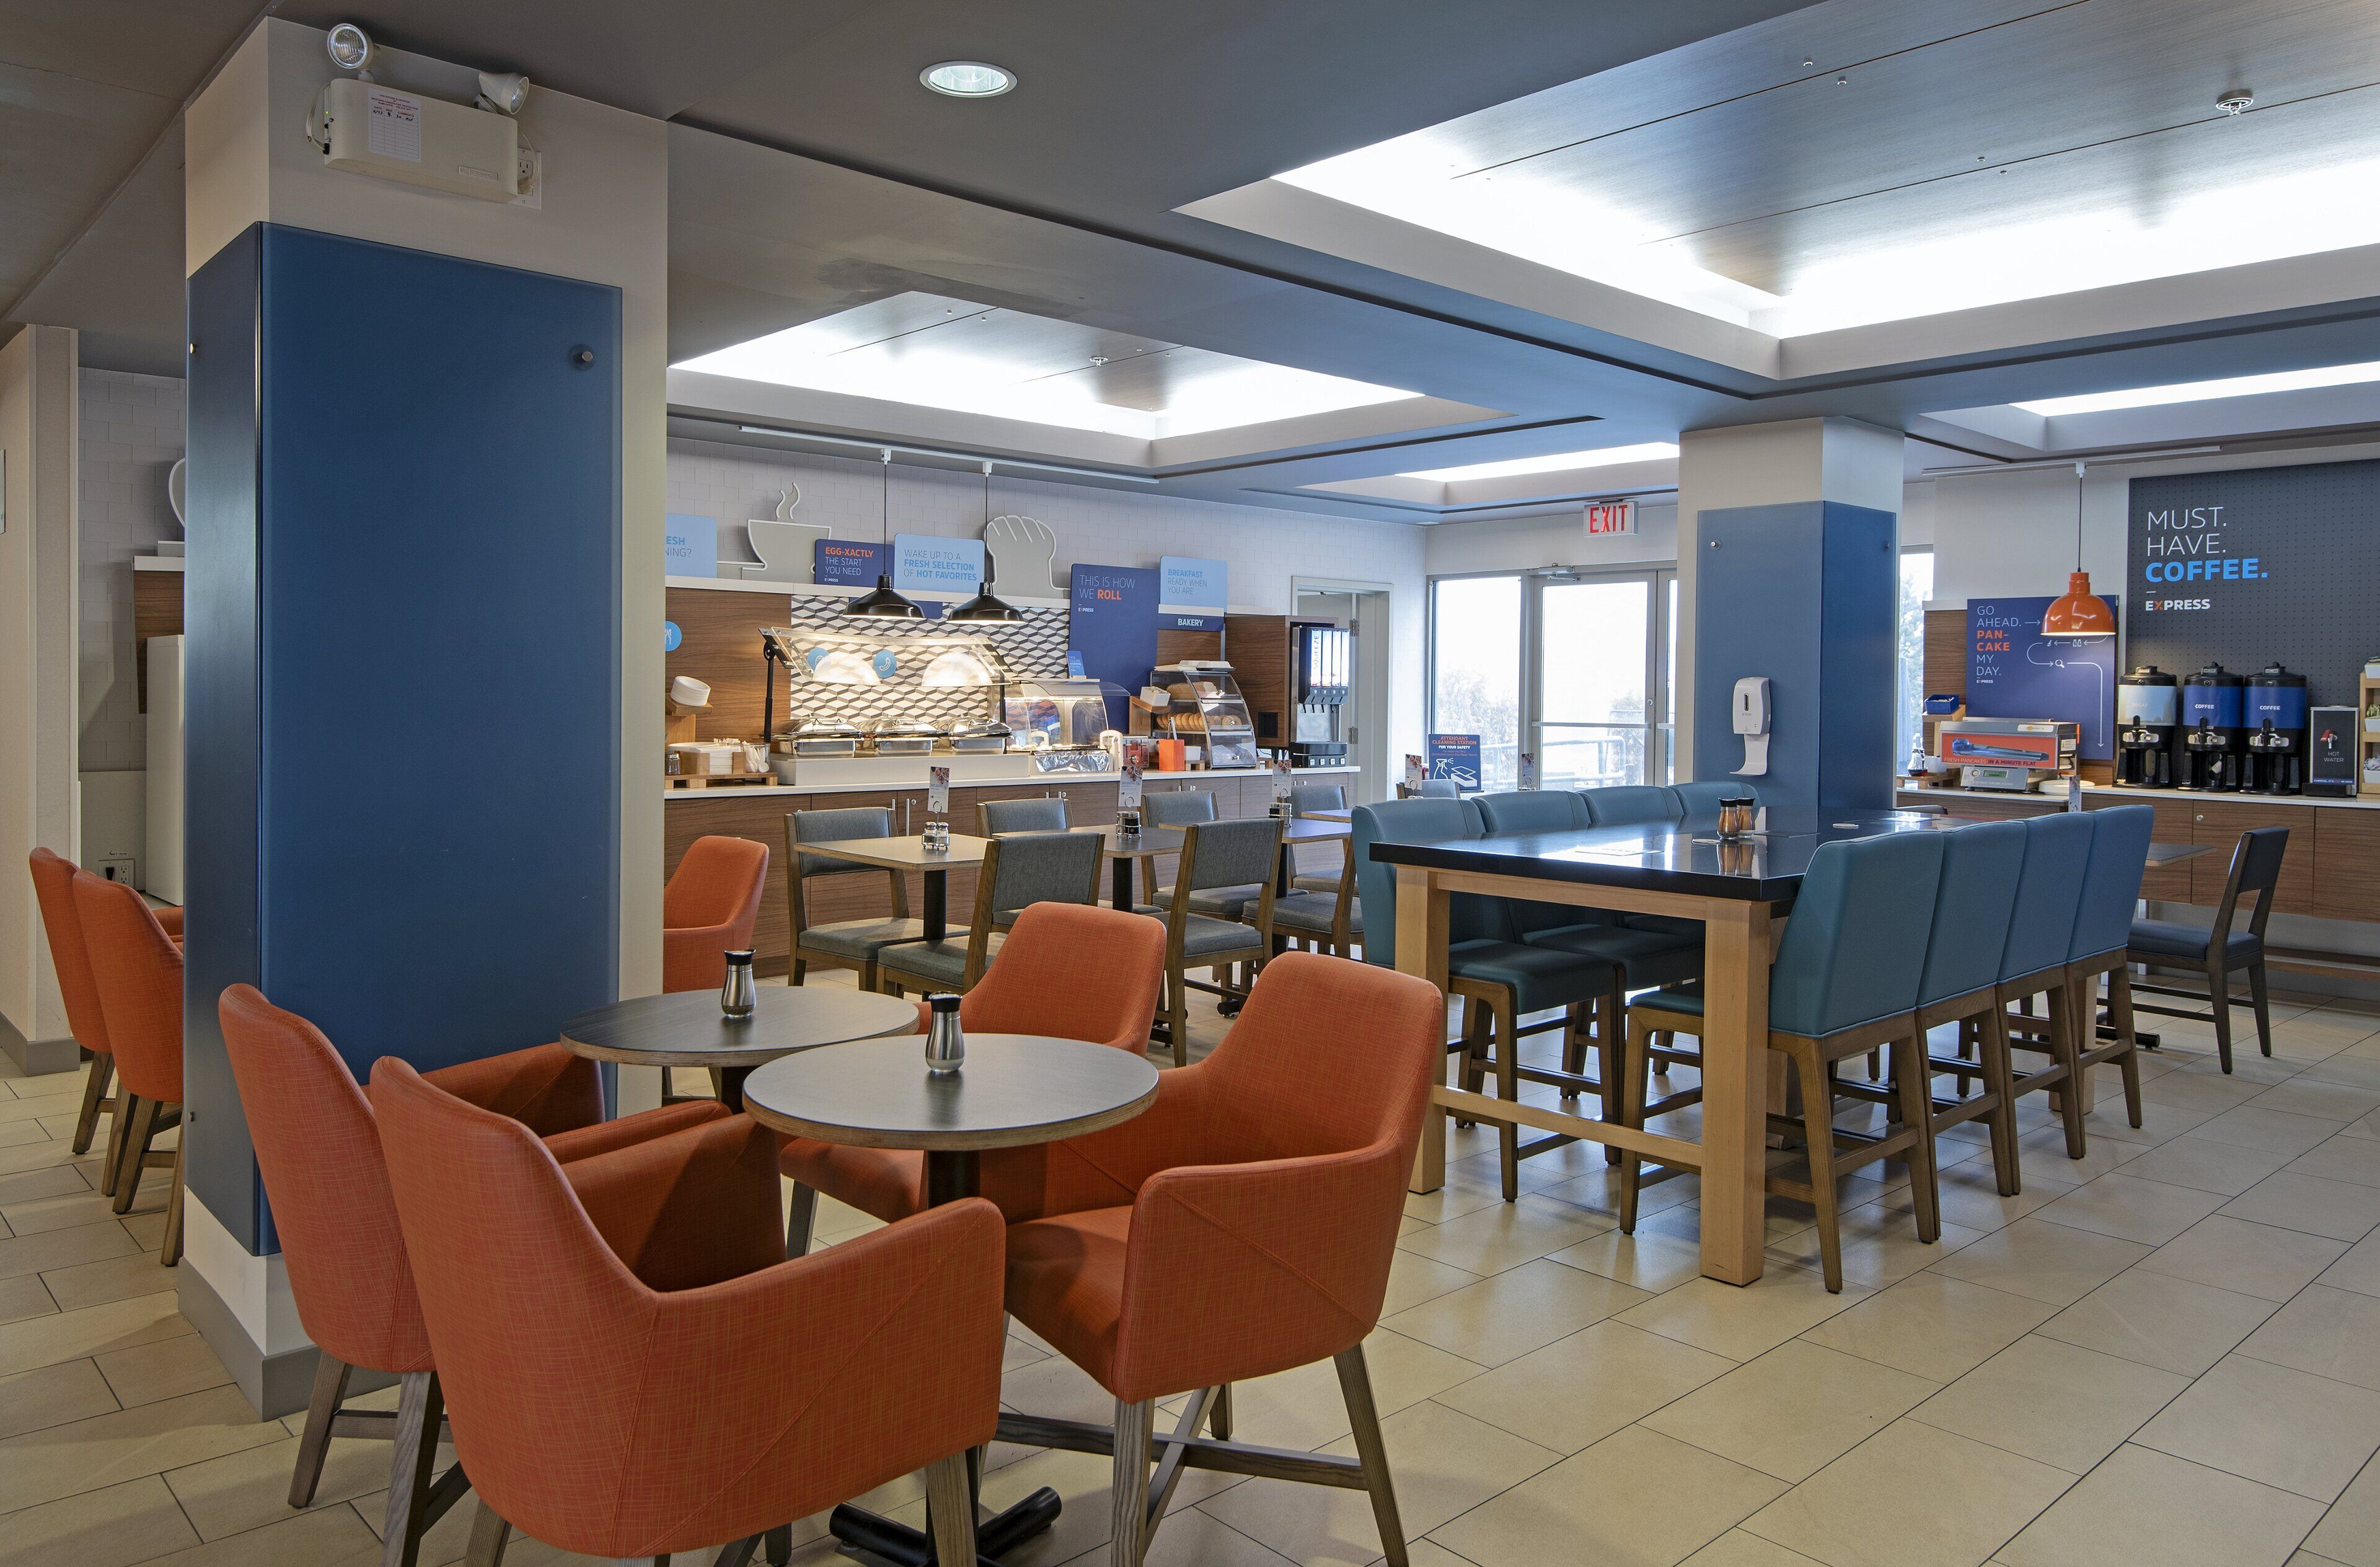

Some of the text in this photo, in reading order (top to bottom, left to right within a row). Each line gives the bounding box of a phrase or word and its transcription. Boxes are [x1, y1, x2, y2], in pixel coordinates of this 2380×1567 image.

[1590, 505, 1628, 533] EXIT
[2148, 506, 2227, 531] MUST.
[666, 536, 684, 545] ESH
[2147, 533, 2226, 557] HAVE.
[666, 547, 692, 557] NING?
[825, 547, 874, 557] EGG-XACTLY
[904, 549, 961, 561] WAKE UP TO A
[825, 557, 862, 566] THE START
[904, 559, 974, 571] FRESH SELECTION
[825, 566, 862, 575] YOU NEED
[904, 568, 977, 581] OF HOT FAVORITES
[1168, 569, 1203, 578] BREAKFAST
[2145, 558, 2268, 583] COFFEE.
[1080, 575, 1135, 588] THIS IS HOW
[1168, 578, 1188, 586] READY
[1079, 588, 1122, 600] WE ROLL
[2145, 598, 2211, 611] EXPRESS
[1977, 606, 1994, 616] GO
[1178, 618, 1204, 627] BAKERY
[1977, 617, 2022, 627] AHEAD.
[1977, 630, 2009, 639] PAN-
[1977, 642, 2010, 651] CAKE
[1977, 655, 1994, 664] MY
[1977, 666, 2001, 676] DAY.
